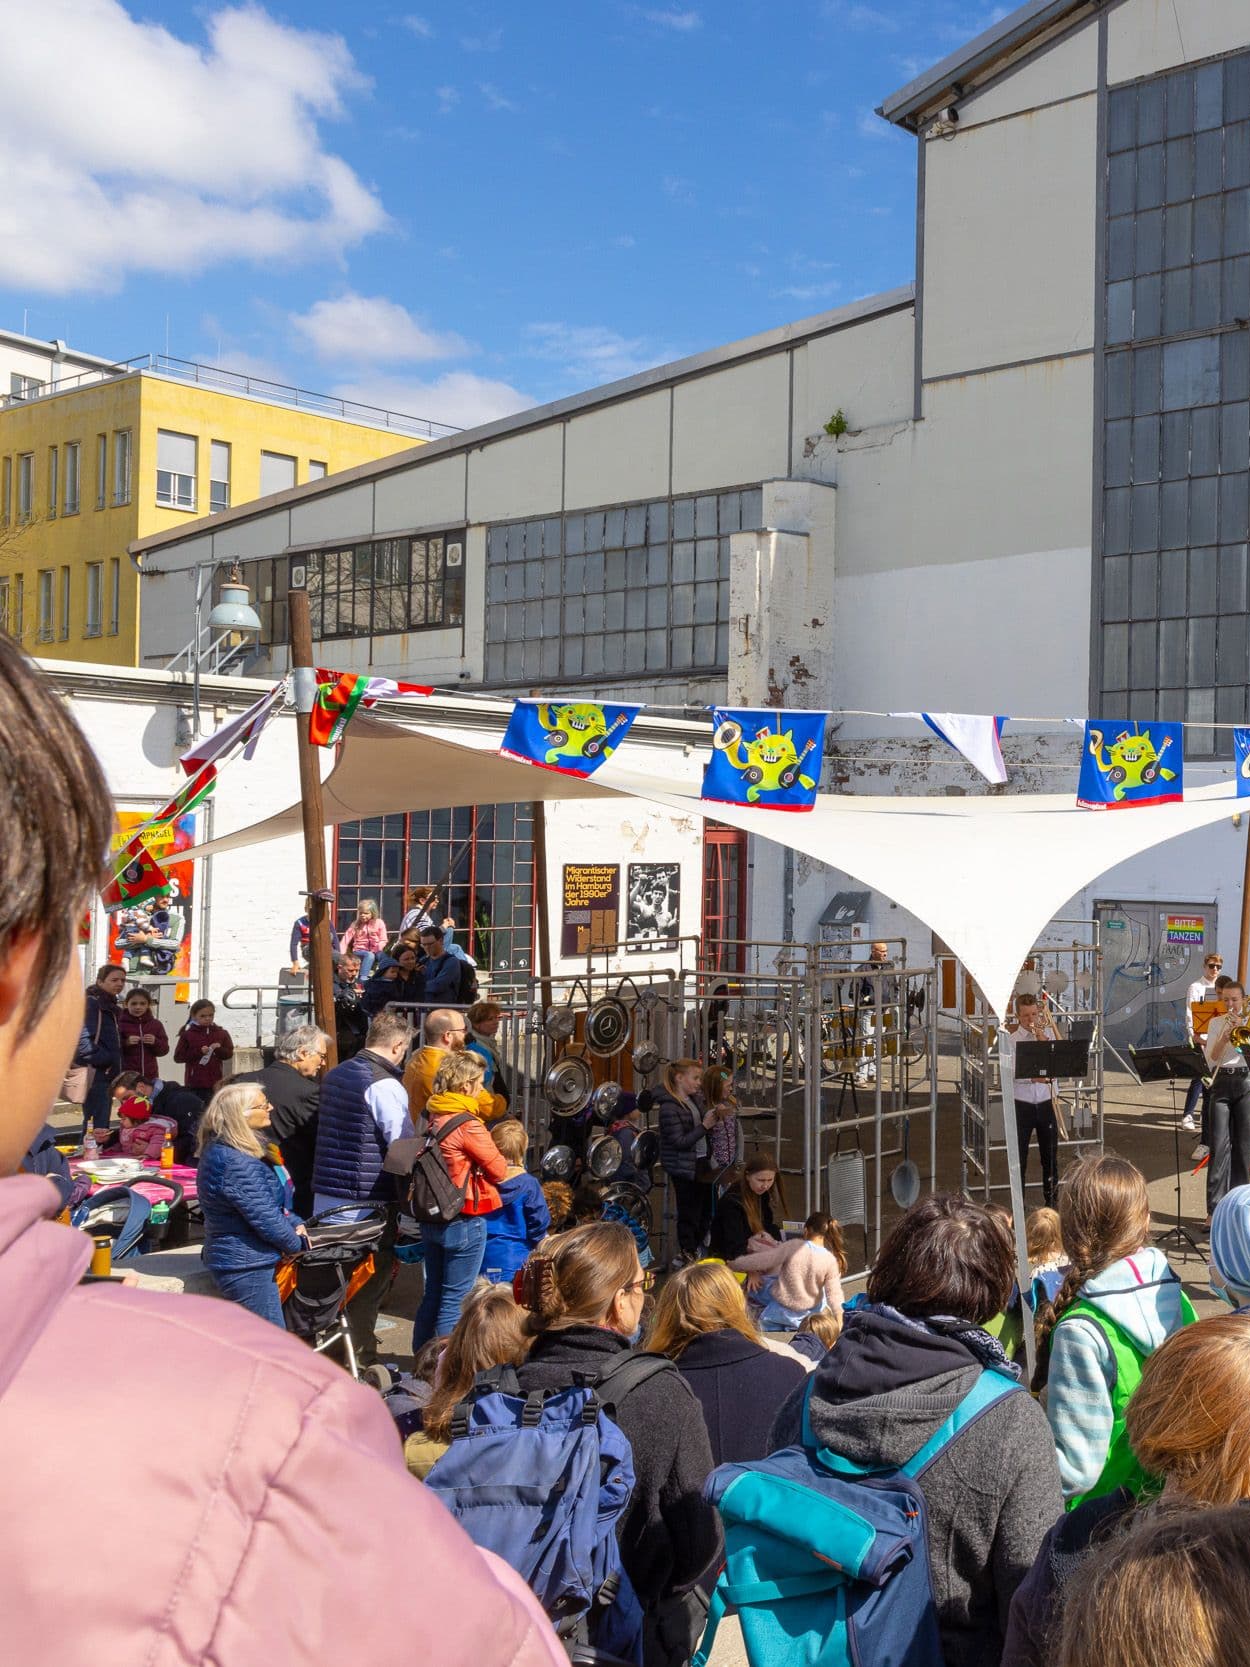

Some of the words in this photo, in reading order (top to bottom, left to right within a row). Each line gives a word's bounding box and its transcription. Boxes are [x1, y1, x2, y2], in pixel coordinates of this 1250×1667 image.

[566, 866, 616, 875] Migrantischer
[576, 882, 612, 892] Hamburg
[565, 890, 580, 898] der
[580, 889, 608, 898] 1990er
[565, 898, 589, 906] Jahre
[1175, 919, 1196, 928] BITTE
[1170, 931, 1201, 940] TANZEN
